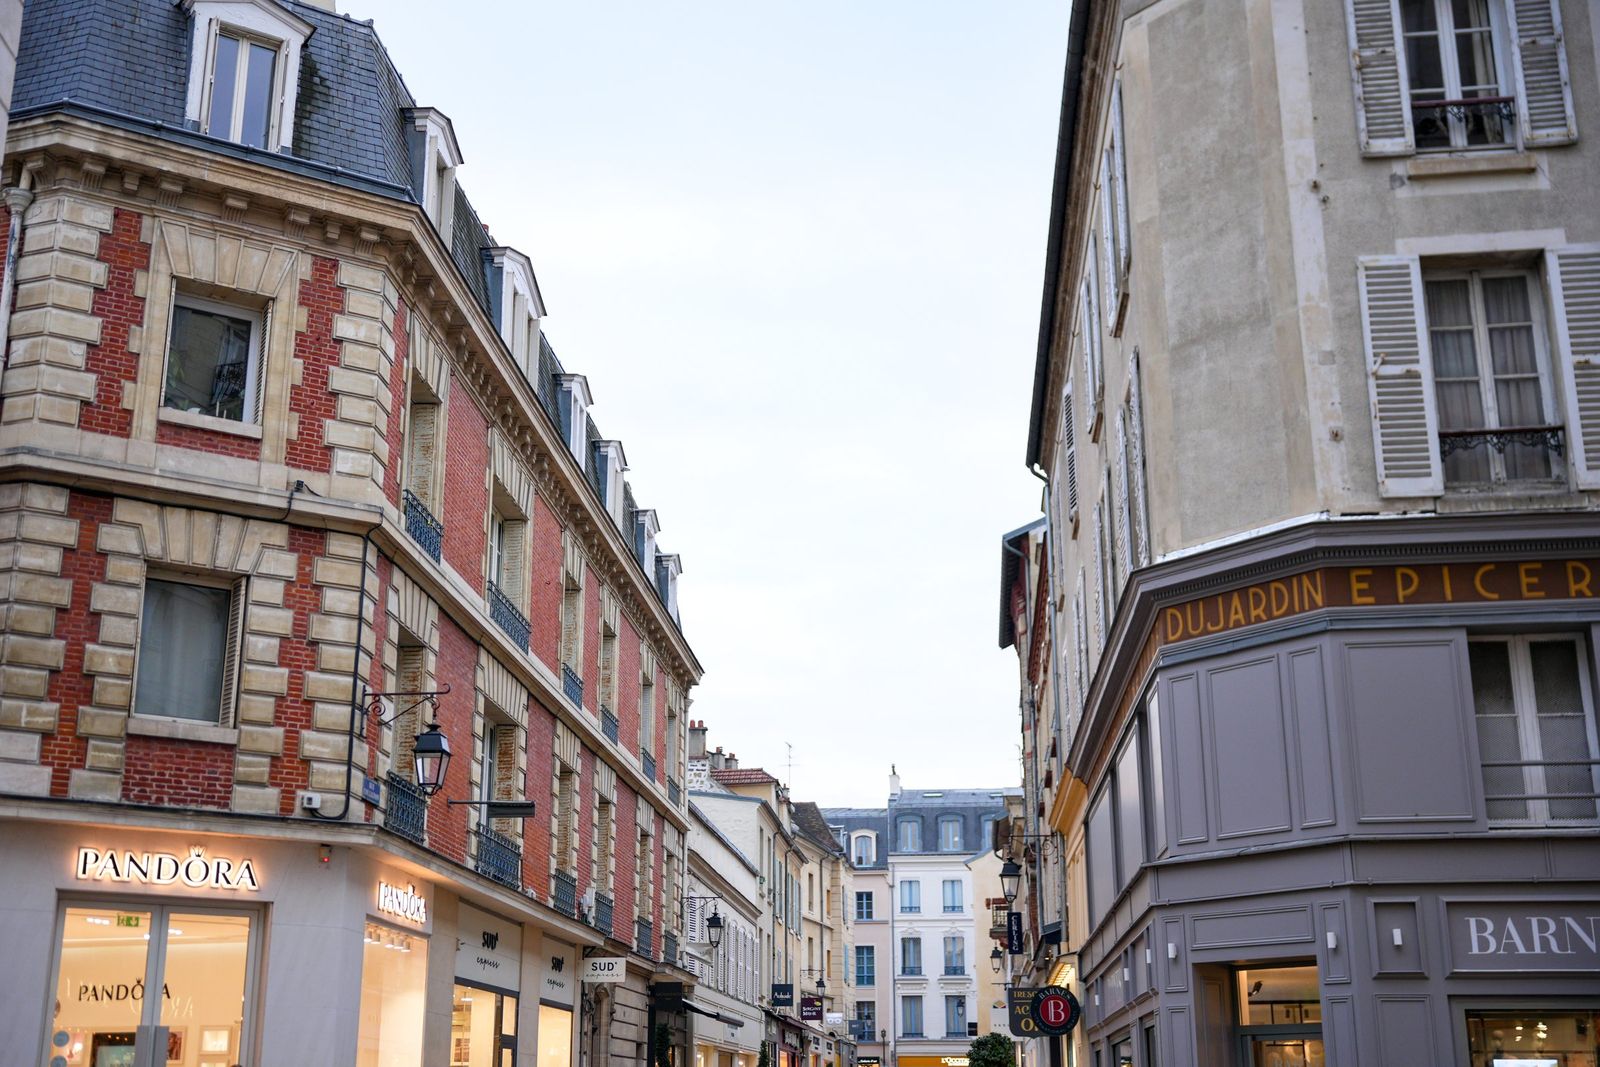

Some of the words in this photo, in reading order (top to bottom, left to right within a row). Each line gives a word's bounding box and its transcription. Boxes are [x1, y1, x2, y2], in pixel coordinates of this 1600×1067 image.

[1349, 561, 1593, 605] EPICER
[1166, 570, 1323, 642] DUJARDIN
[77, 846, 260, 890] PANDORA
[1464, 917, 1600, 954] BARN
[78, 978, 171, 1002] PANDOA
[1048, 999, 1065, 1022] B
